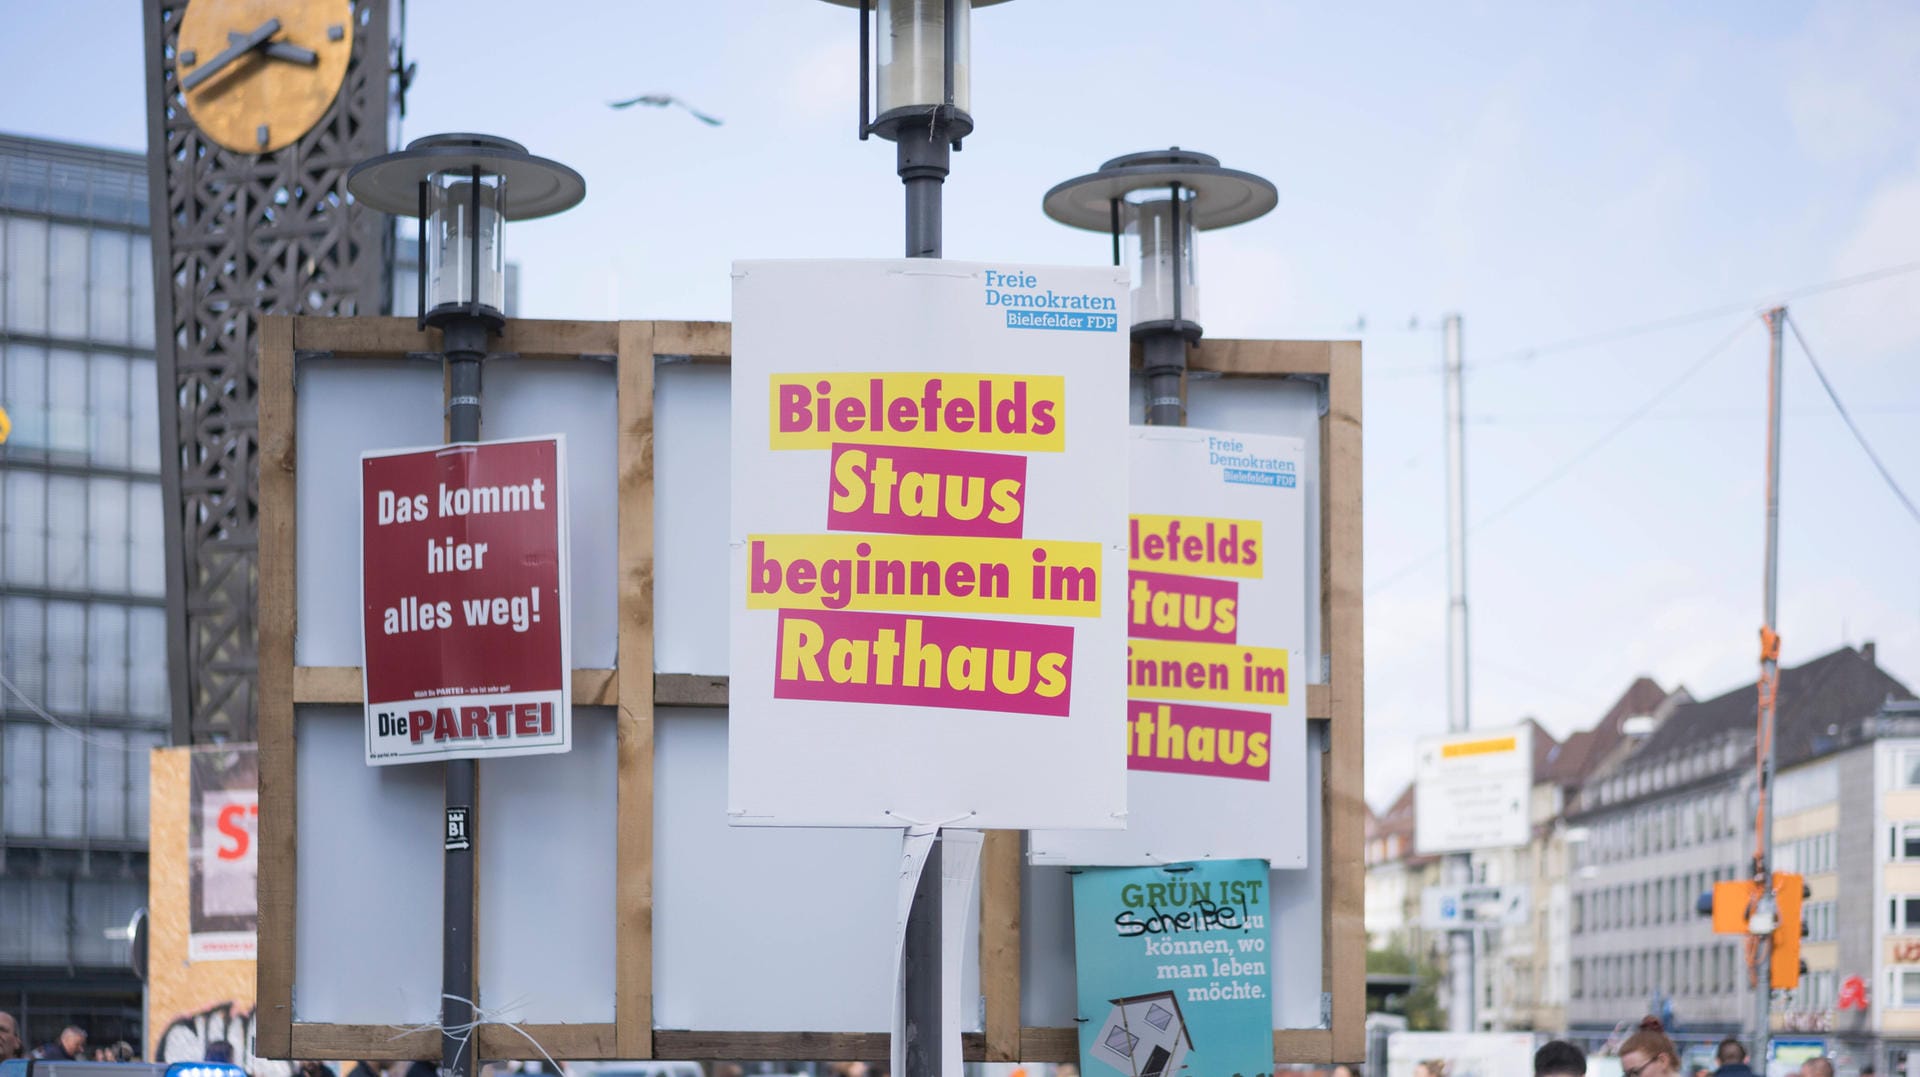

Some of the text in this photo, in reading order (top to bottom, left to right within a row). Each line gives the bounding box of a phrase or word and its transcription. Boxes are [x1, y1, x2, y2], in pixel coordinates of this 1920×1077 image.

[985, 270, 1037, 288] Freie
[985, 289, 1116, 310] Demokraten
[1008, 313, 1115, 329] Bielefelder FDP
[779, 379, 1056, 435] Bielefelds
[1209, 437, 1243, 453] Freie
[1210, 452, 1296, 471] Demokraten
[378, 478, 545, 526] Das kommt
[832, 449, 1021, 524] Staus
[428, 537, 487, 574] hier
[1129, 519, 1257, 566] lefelds
[750, 541, 1096, 609] beginnen im
[384, 586, 540, 635] alles weg!
[1128, 579, 1236, 634] taus
[780, 618, 1067, 697] Rathaus
[1127, 646, 1285, 694] innen im
[436, 687, 463, 696] PARTEI
[378, 701, 555, 745] Die PARTEI
[1127, 705, 1268, 767] thaus
[217, 803, 258, 862] S
[1121, 877, 1262, 908] GRÜN IST
[1145, 936, 1265, 957] können, wo
[1157, 957, 1266, 979] man leben
[1188, 980, 1265, 1002] möchte.
